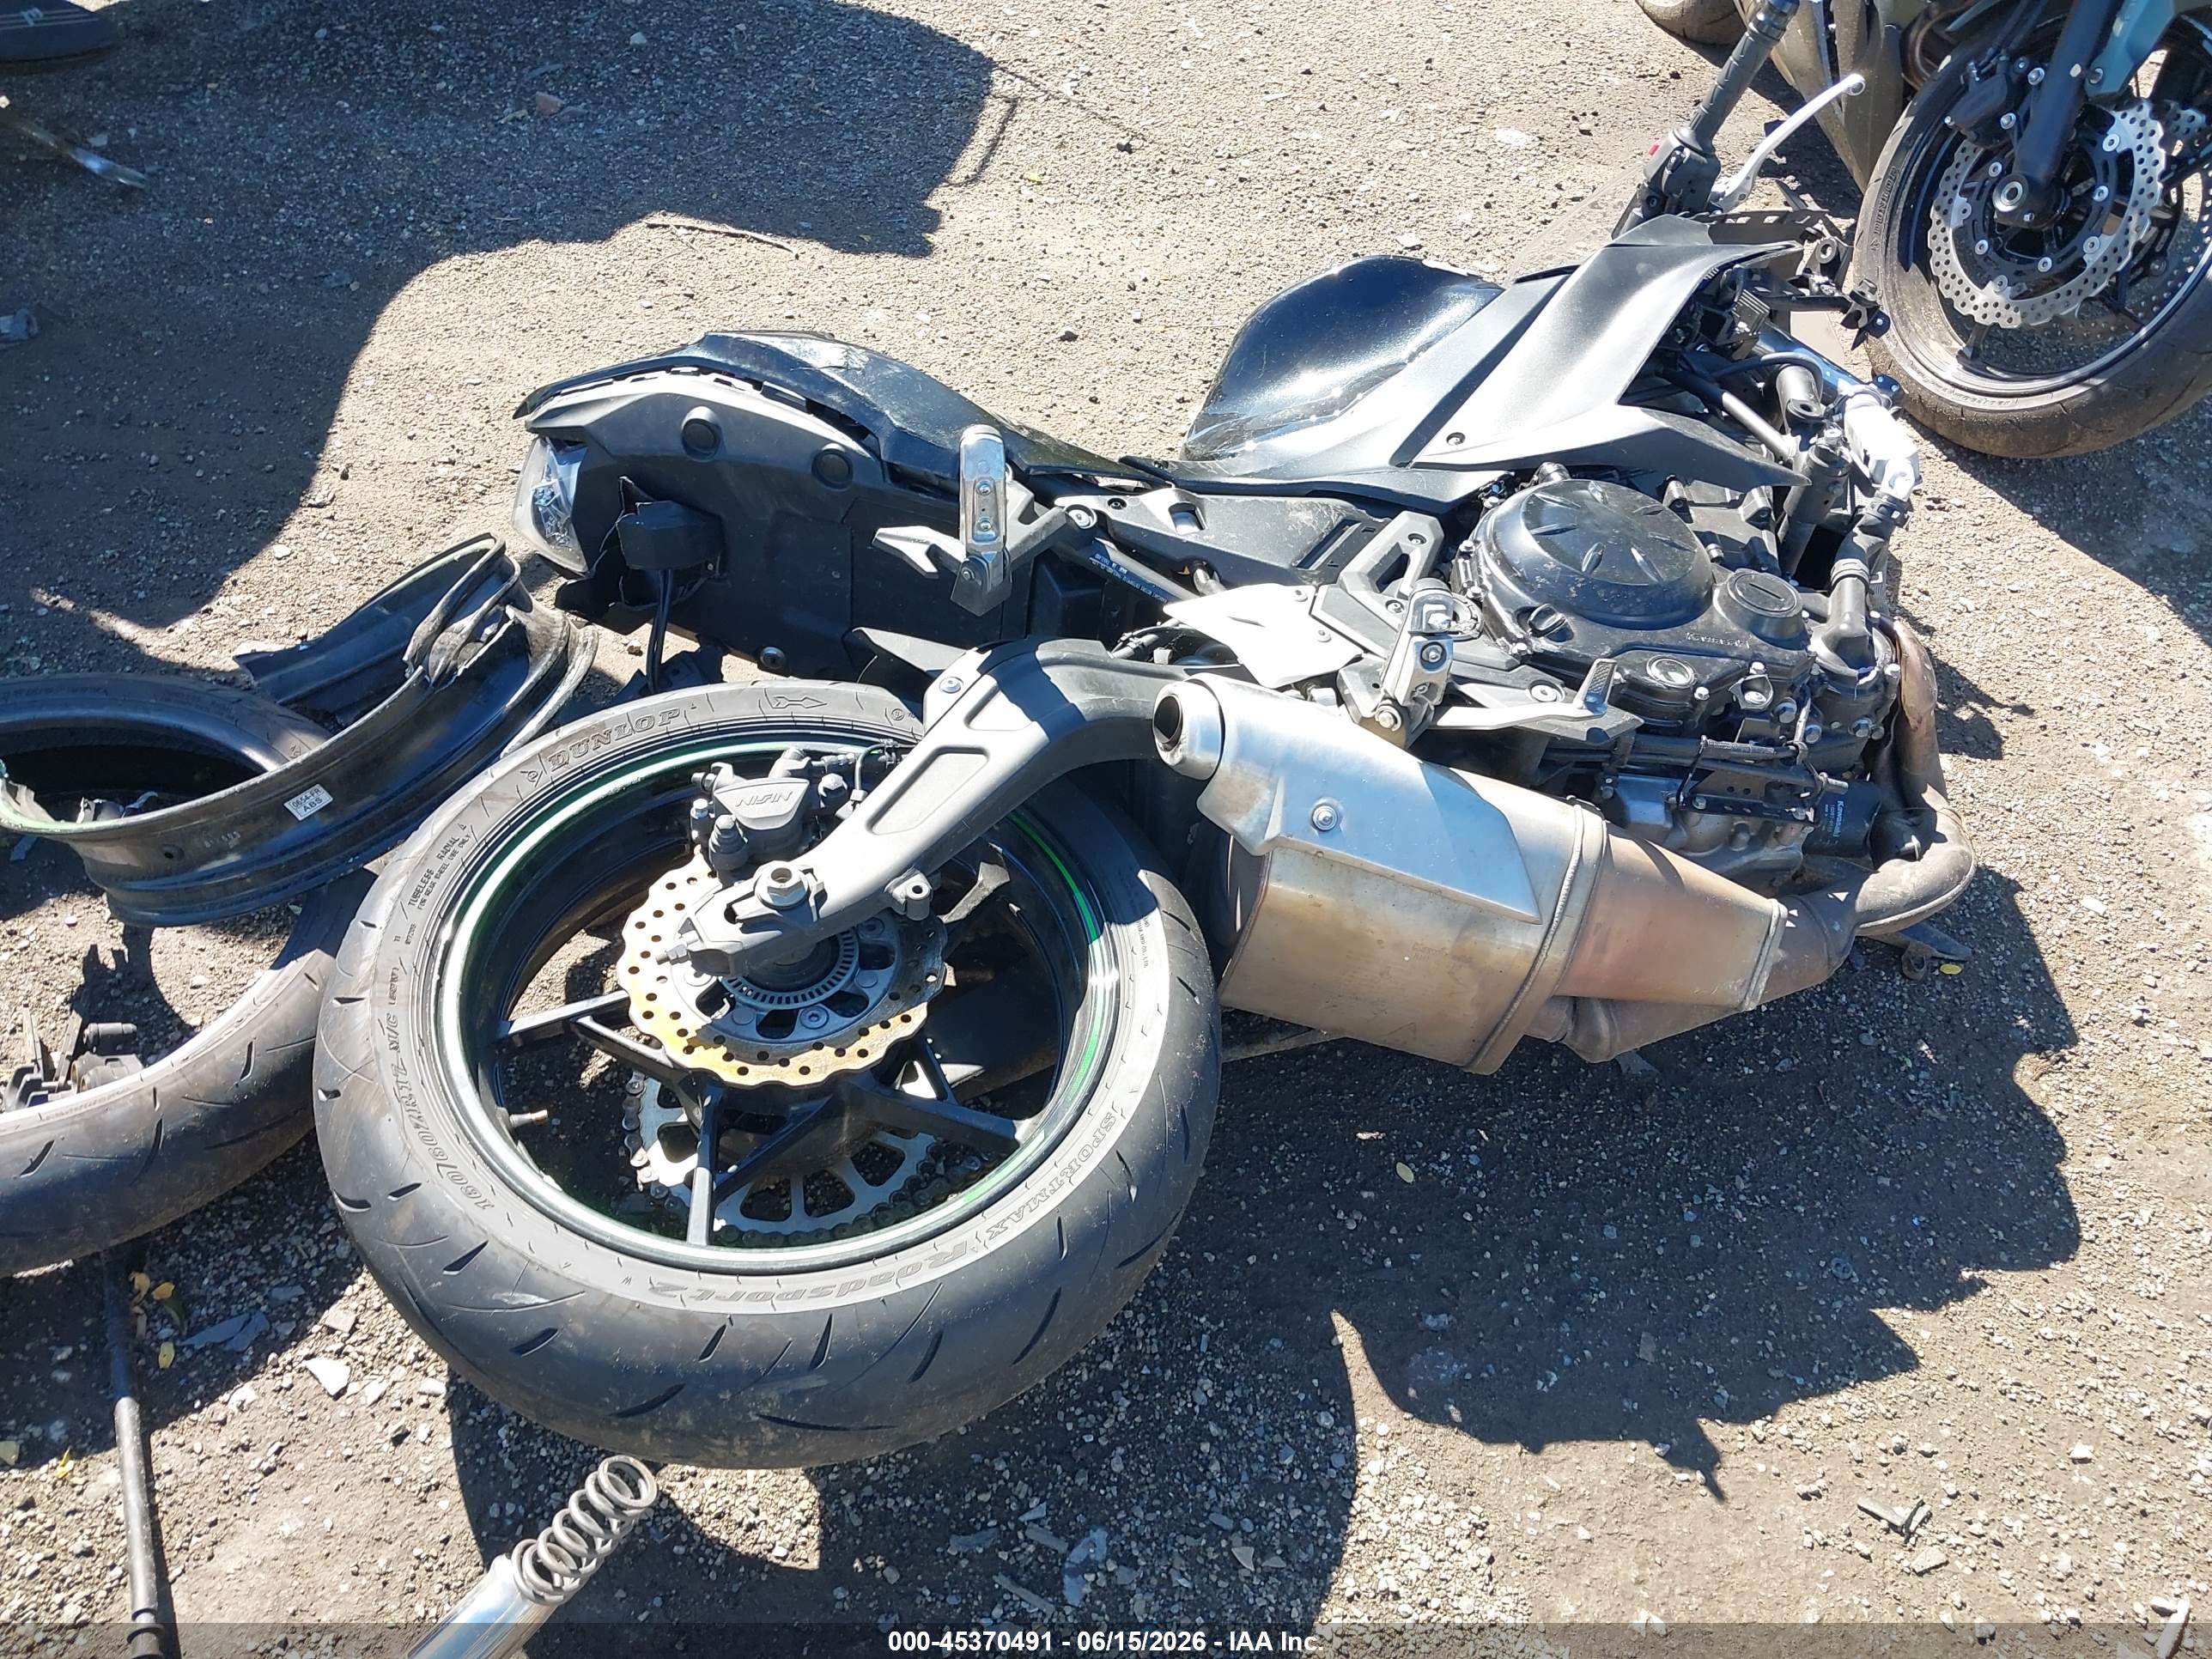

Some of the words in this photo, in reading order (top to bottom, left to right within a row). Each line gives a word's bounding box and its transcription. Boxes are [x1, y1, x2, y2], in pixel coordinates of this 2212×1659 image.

[1874, 166, 1897, 234] DUNLOP
[548, 708, 681, 772] DUNLOP
[303, 797, 323, 812] ABS
[1832, 800, 1844, 837] Kawasaki
[408, 868, 434, 907] TUBELESS
[436, 837, 460, 860] RADIAL
[986, 1112, 1116, 1241] SPORTMAX
